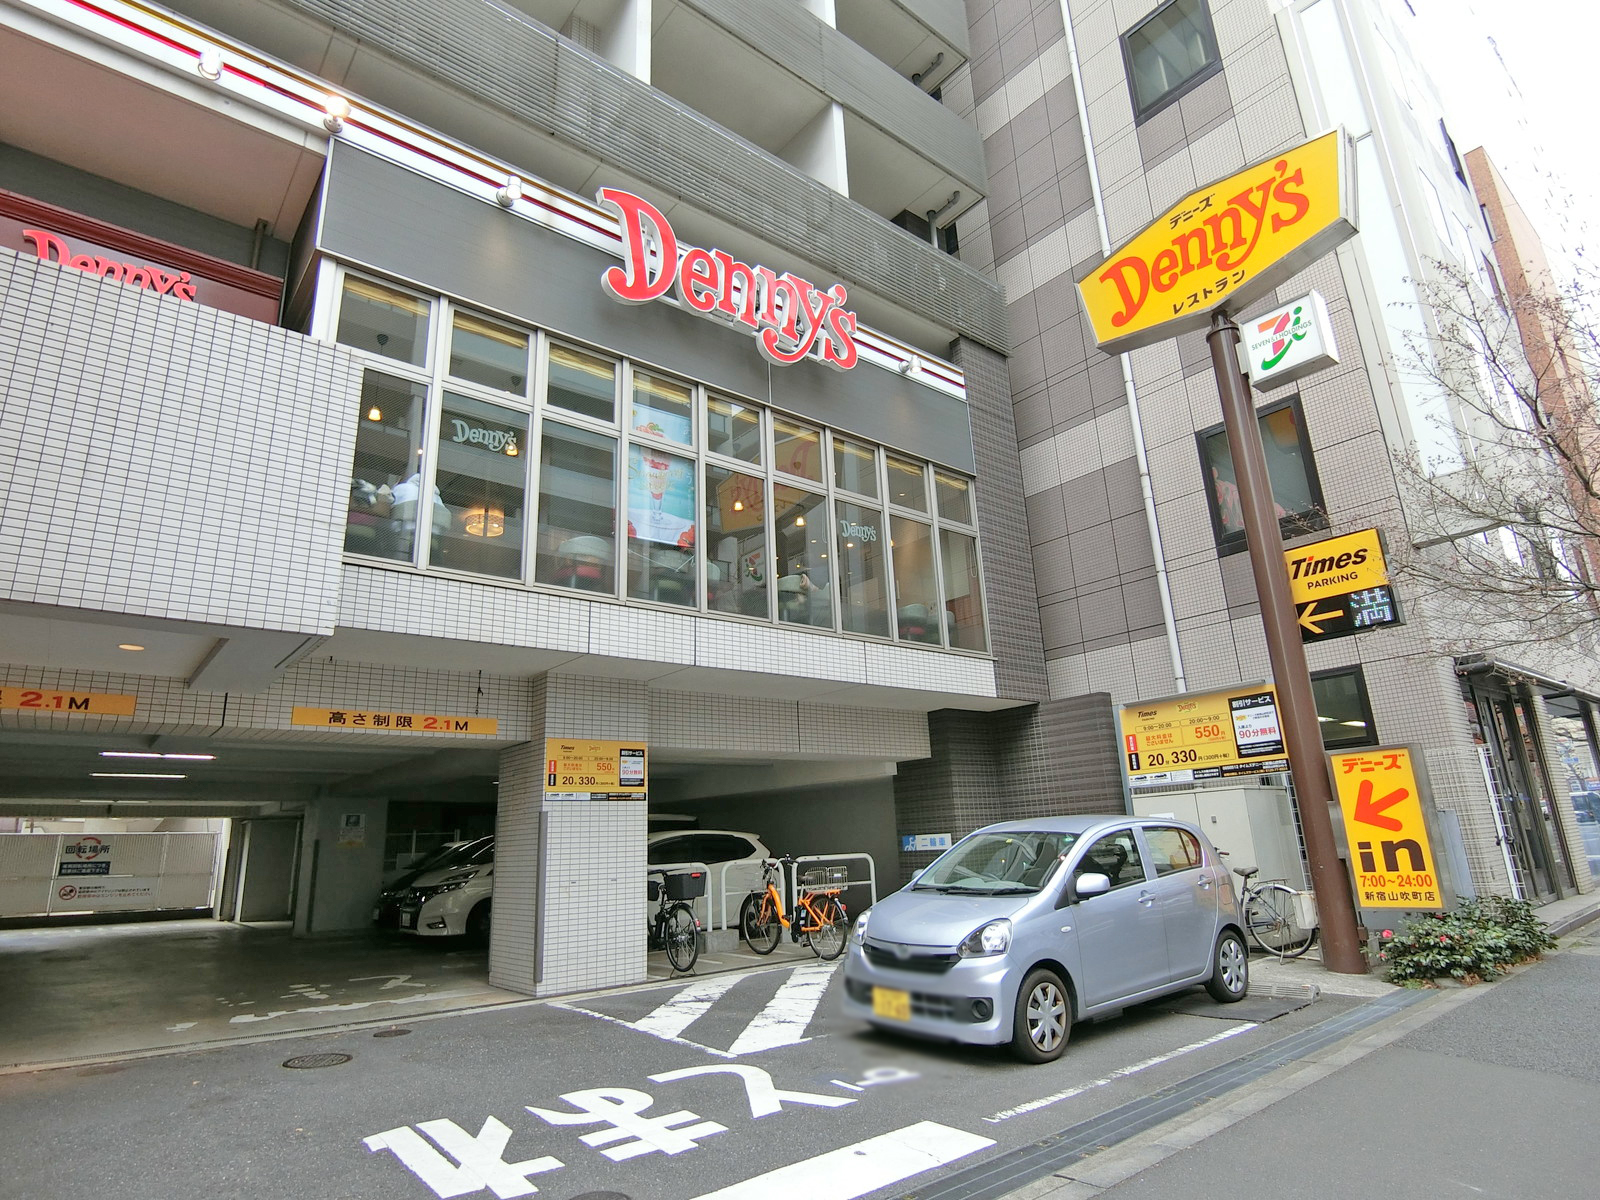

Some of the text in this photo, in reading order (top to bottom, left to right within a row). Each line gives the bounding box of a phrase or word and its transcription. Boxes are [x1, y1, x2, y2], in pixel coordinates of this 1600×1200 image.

[1170, 193, 1216, 229] デニーズ
[1099, 159, 1310, 328] Denny's
[596, 187, 858, 372] Denny's
[1173, 269, 1246, 314] レストラン
[1252, 336, 1270, 350] SEVEN
[1279, 320, 1312, 338] HOLDINGS
[452, 419, 517, 454] Denny's
[840, 520, 877, 542] Denny's
[1291, 548, 1368, 580] Times
[1307, 571, 1358, 590] PARKING
[1350, 587, 1391, 627] 満
[329, 711, 413, 729] 高さ制限
[1137, 710, 1158, 718] Times
[1342, 754, 1405, 774] デニーズ
[65, 844, 111, 854] 回転場所
[1357, 839, 1427, 873] in
[1360, 874, 1433, 888] 7:00~24:00
[1364, 890, 1436, 902] 新宿山吹町店
